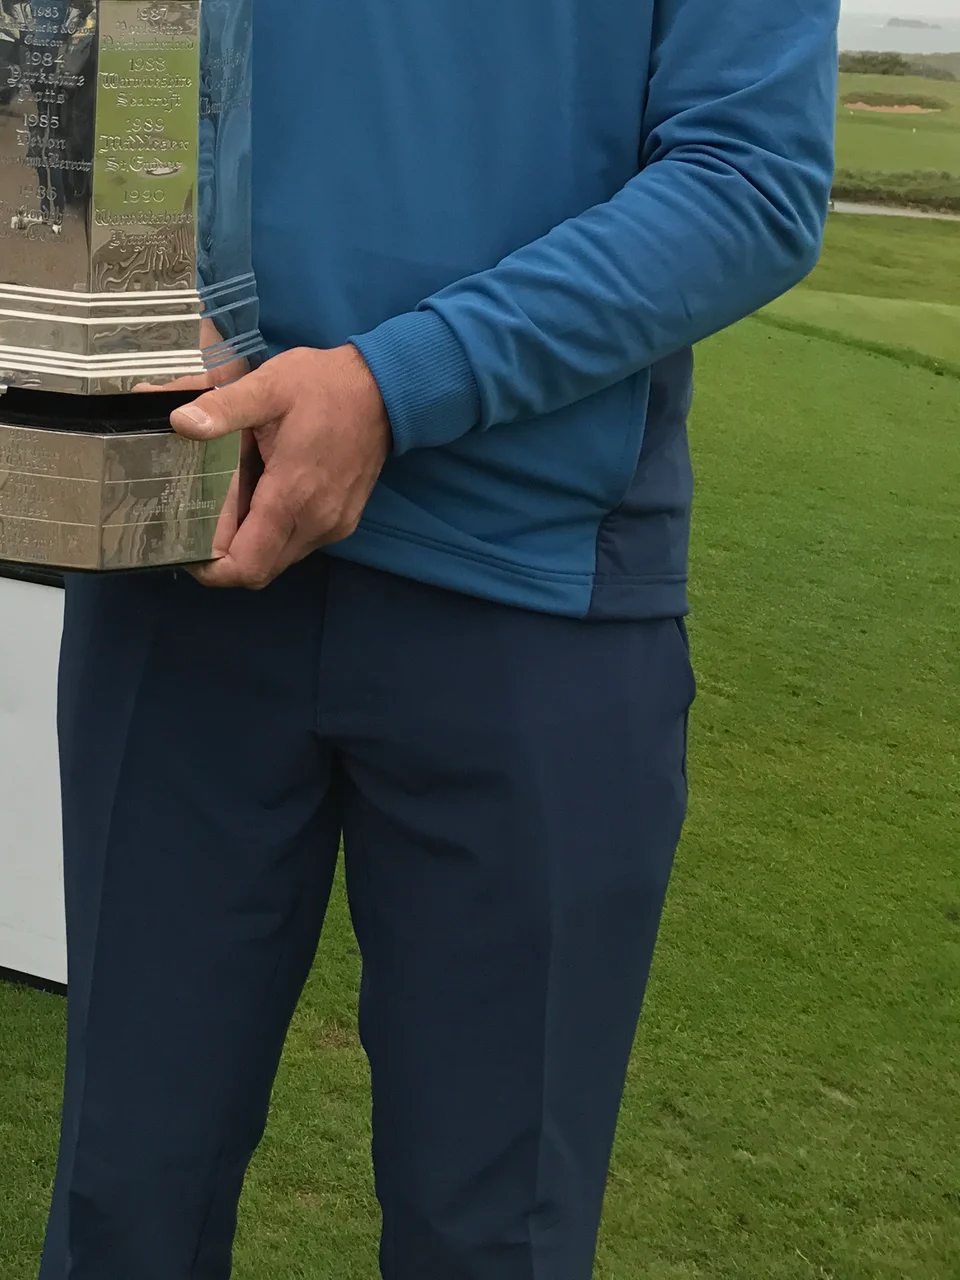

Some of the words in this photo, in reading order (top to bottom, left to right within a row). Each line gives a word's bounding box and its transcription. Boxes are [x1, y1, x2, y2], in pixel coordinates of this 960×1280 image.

[137, 7, 169, 21] 1987
[25, 51, 66, 68] 1984
[128, 56, 167, 72] 1988
[23, 113, 60, 129] 1985
[126, 118, 165, 133] 1989
[123, 190, 165, 204] 1990
